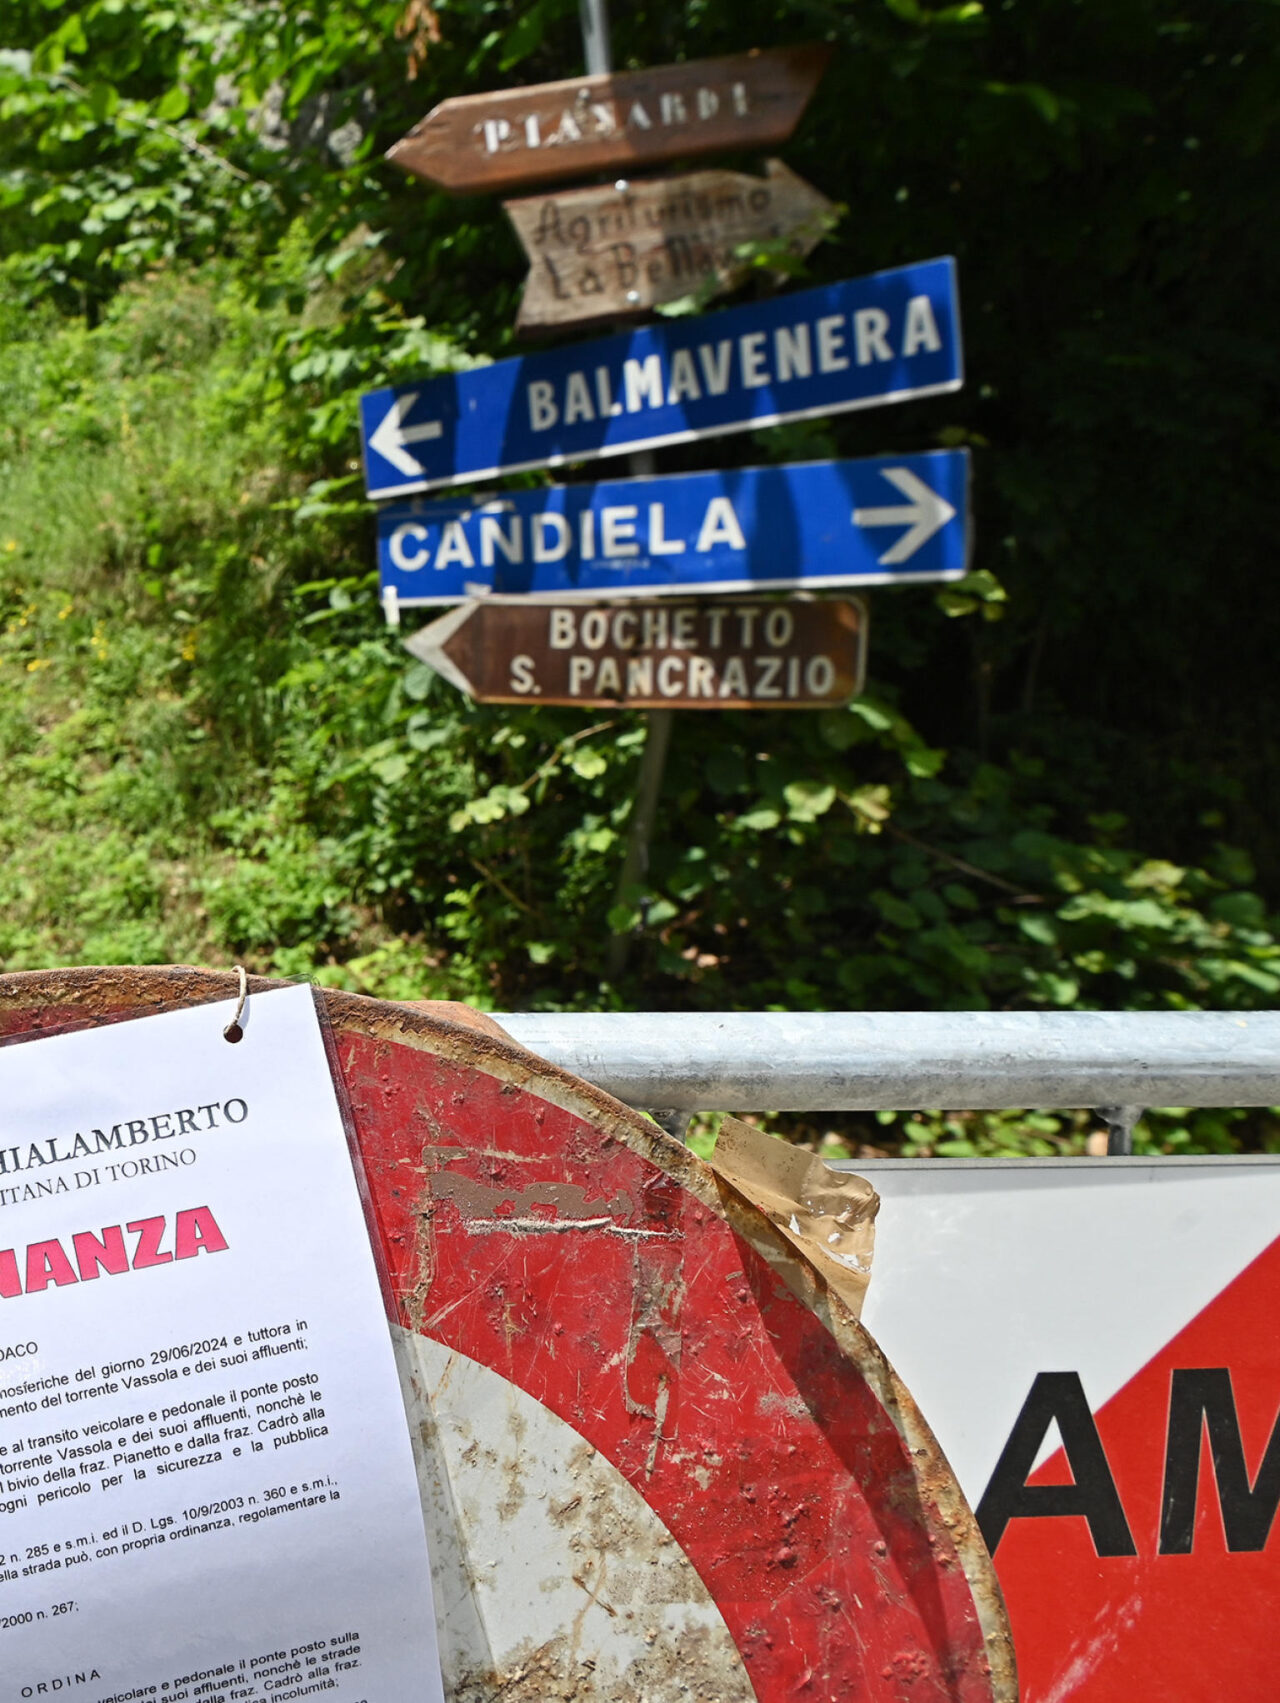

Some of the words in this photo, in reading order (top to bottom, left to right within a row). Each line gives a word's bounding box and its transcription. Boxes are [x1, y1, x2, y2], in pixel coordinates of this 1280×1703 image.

[527, 294, 942, 432] BALMAVENERA
[387, 496, 747, 573] CANDIELA
[549, 606, 795, 651] BOCHETTO
[509, 654, 543, 695] S.
[568, 654, 836, 699] PANCRAZIO
[72, 1166, 102, 1190] DI
[103, 1146, 197, 1182] TORINO
[39, 1391, 63, 1410] del
[63, 1380, 120, 1404] torrente
[119, 1366, 179, 1390] Vassola
[193, 1355, 217, 1374] dei
[218, 1348, 249, 1369] suoi
[250, 1335, 309, 1362] affluenti;
[73, 1364, 97, 1383] del
[99, 1356, 146, 1380] giorno
[148, 1335, 229, 1366] 29/06/2024
[246, 1323, 292, 1344] tuttora
[25, 1427, 80, 1451] transito
[80, 1413, 146, 1438] veicolare
[160, 1393, 227, 1423] pedonale
[239, 1381, 279, 1404] ponte
[280, 1371, 320, 1394] posto
[55, 1437, 114, 1461] Vassola
[130, 1426, 155, 1445] dei
[157, 1418, 189, 1439] suoi
[191, 1404, 252, 1431] affluenti,
[254, 1391, 306, 1416] nonchè
[5, 1473, 41, 1493] bivio
[41, 1464, 77, 1485] della
[77, 1458, 110, 1476] fraz.
[111, 1443, 171, 1468] Pianetto
[185, 1431, 221, 1450] dalla
[222, 1425, 254, 1441] fraz.
[256, 1411, 300, 1433] Cadrò
[301, 1406, 326, 1423] alla
[35, 1480, 92, 1508] pericolo
[99, 1473, 124, 1492] per
[155, 1450, 223, 1476] sicurezza
[271, 1424, 330, 1451] pubblica
[974, 1367, 1280, 1558] AM
[20, 1557, 62, 1577] strada
[63, 1549, 93, 1569] può,
[94, 1544, 119, 1559] con
[120, 1532, 167, 1555] propria
[167, 1517, 236, 1541] ordinanza,
[237, 1493, 327, 1524] regolamentare
[24, 1542, 50, 1560] 285
[63, 1531, 99, 1551] s.m.i.
[101, 1525, 119, 1542] ed
[130, 1519, 147, 1534] D.
[148, 1514, 178, 1531] Lgs.
[180, 1495, 245, 1522] 10/9/2003
[261, 1485, 287, 1502] 360
[50, 1599, 80, 1617] 267;
[160, 1686, 189, 1703] suoi
[192, 1671, 249, 1696] affluenti,
[252, 1658, 302, 1681] nonchè
[319, 1643, 362, 1663] strade
[172, 1662, 236, 1690] pedonale
[248, 1649, 287, 1670] ponte
[289, 1639, 327, 1660] posto
[328, 1630, 361, 1647] sulla
[229, 1686, 260, 1700] fraz.
[262, 1671, 304, 1691] Cadrò
[306, 1665, 331, 1680] alla
[333, 1658, 363, 1673] fraz.
